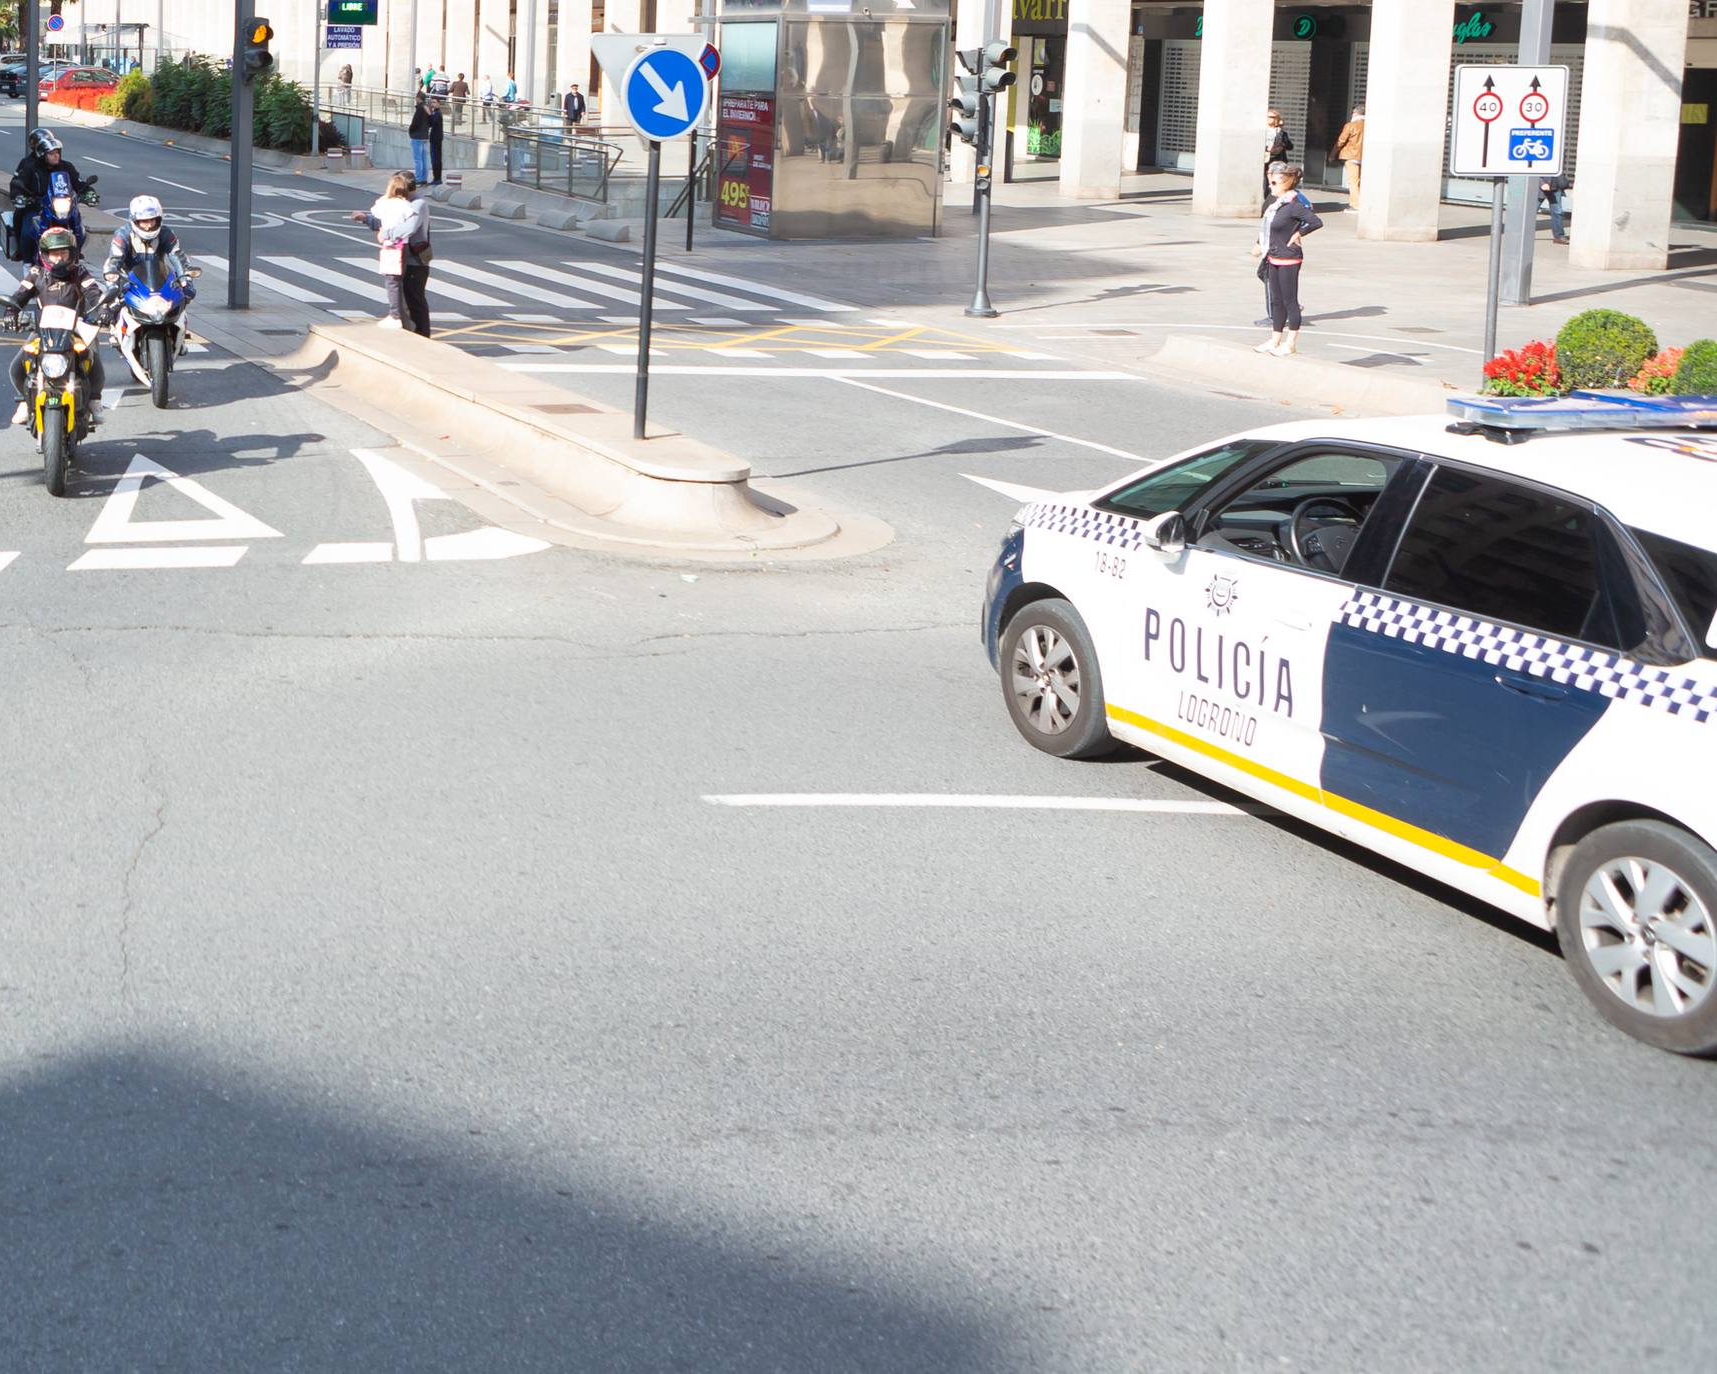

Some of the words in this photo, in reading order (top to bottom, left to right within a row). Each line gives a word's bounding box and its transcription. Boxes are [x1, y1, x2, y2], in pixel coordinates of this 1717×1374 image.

[341, 2, 363, 11] LIBRE
[1479, 102, 1497, 112] 40
[1525, 102, 1543, 112] 30
[1144, 606, 1293, 718] POLICÍA
